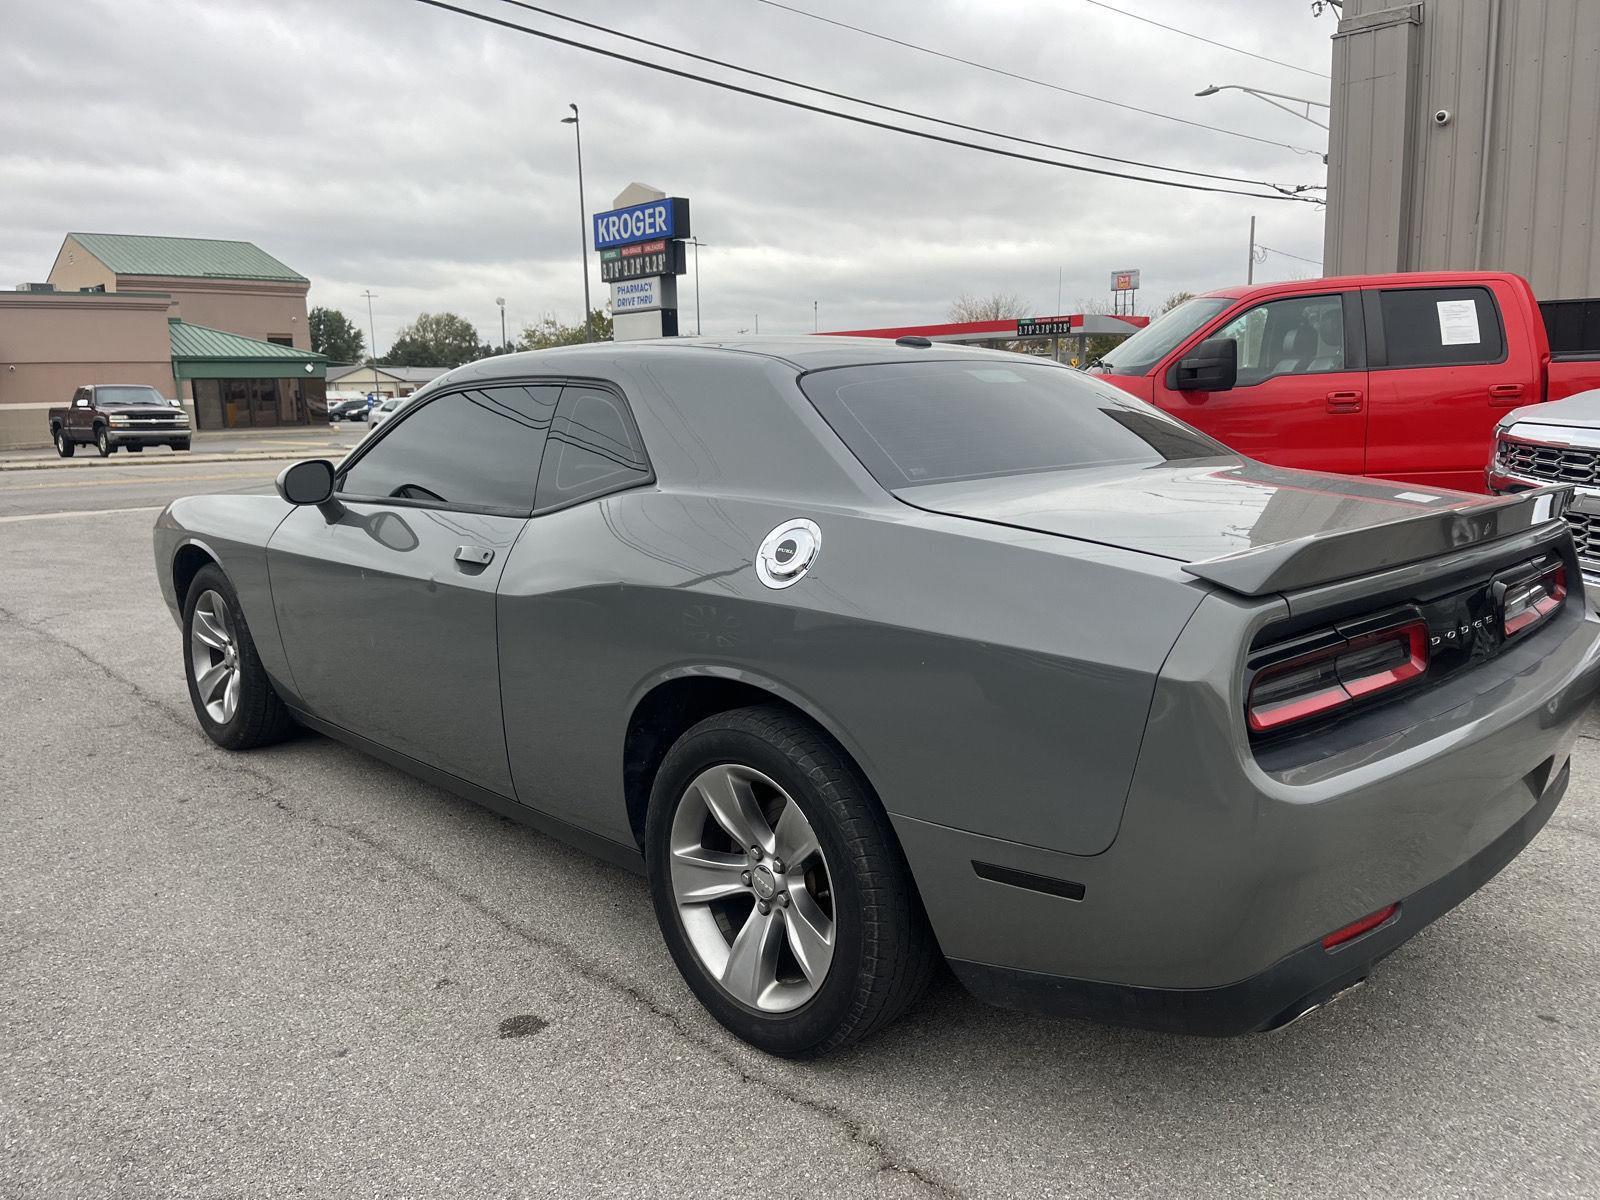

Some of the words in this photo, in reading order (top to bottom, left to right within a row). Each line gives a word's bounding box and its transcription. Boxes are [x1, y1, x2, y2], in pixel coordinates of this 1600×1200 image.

[598, 206, 667, 243] KROGER
[617, 282, 653, 295] PHARMACY
[617, 296, 636, 308] DRIVE
[637, 294, 653, 305] THRU
[1431, 615, 1493, 645] DODGE
